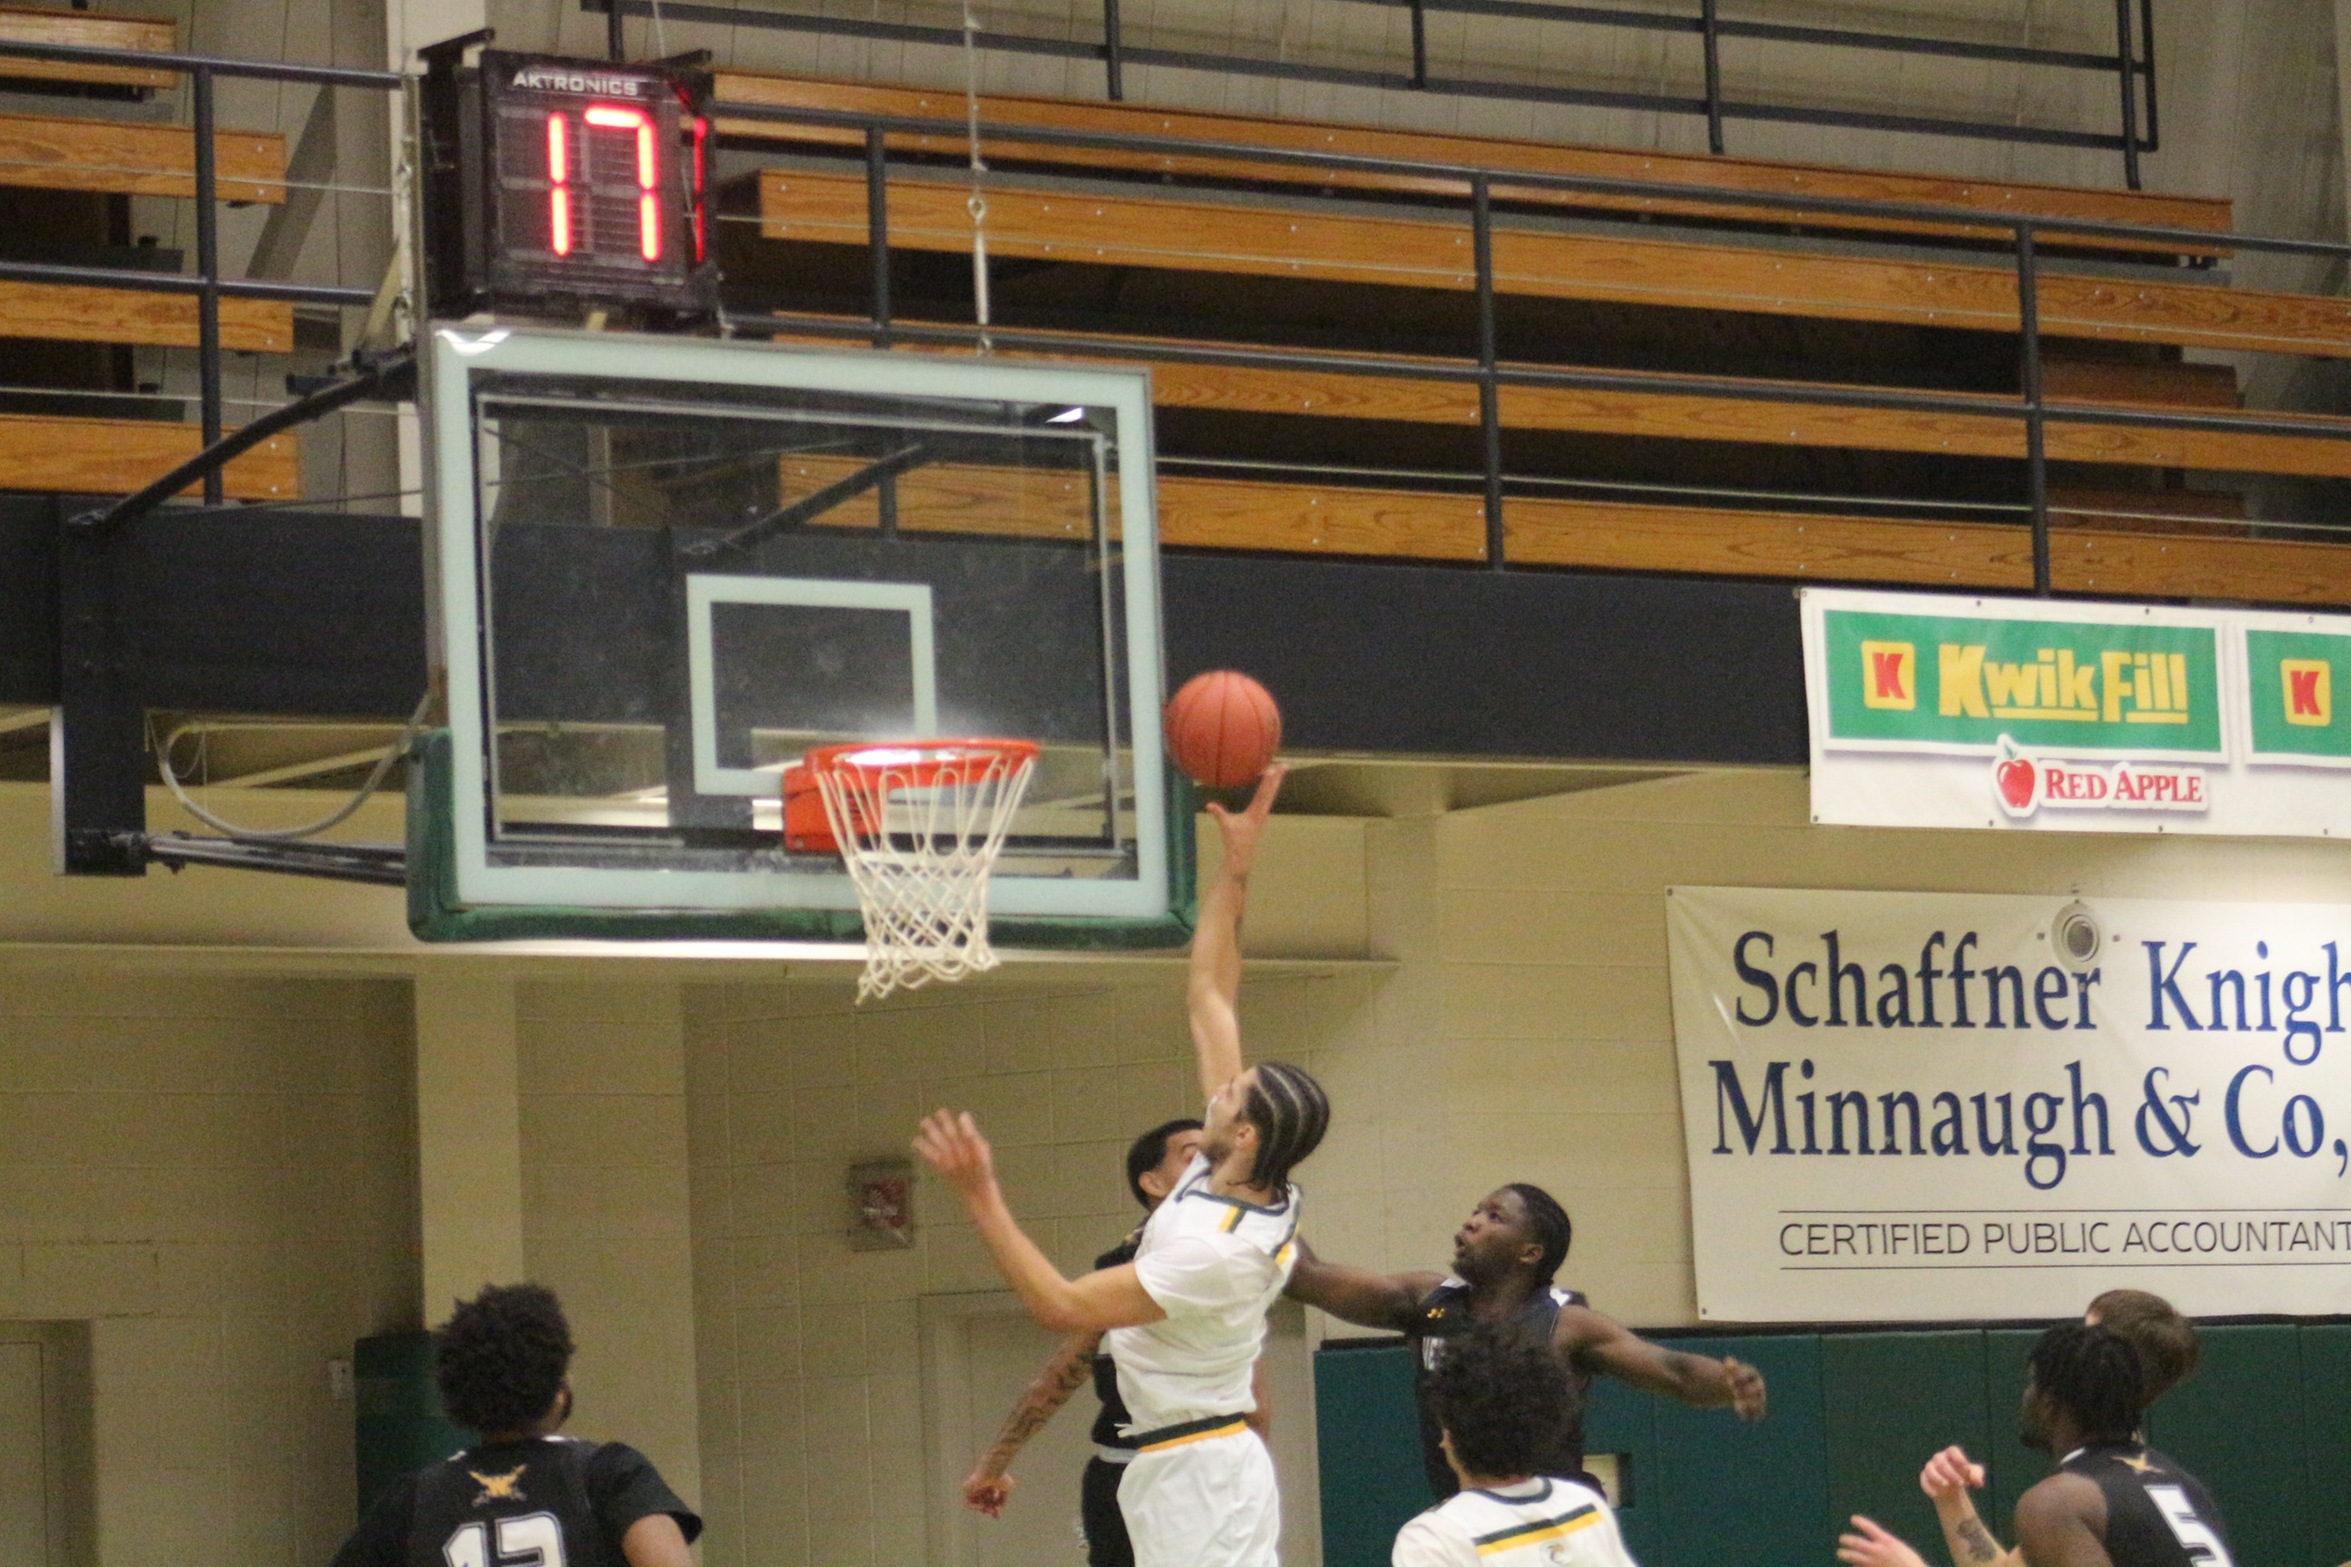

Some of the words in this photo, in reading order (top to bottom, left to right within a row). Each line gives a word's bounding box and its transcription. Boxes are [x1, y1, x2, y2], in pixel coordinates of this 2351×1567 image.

[547, 104, 661, 263] 17
[1871, 652, 1905, 700] K
[2290, 670, 2322, 717] K
[2045, 768, 2108, 802] RED
[2114, 769, 2203, 804] APPLE
[1733, 930, 2100, 1031] Schaffner
[1708, 1059, 2116, 1190] Minnaugh
[2134, 1066, 2202, 1159] &
[2224, 1063, 2350, 1179] Co,
[1778, 1223, 1971, 1257] CERTIFIED
[1984, 1222, 2110, 1255] PUBLIC
